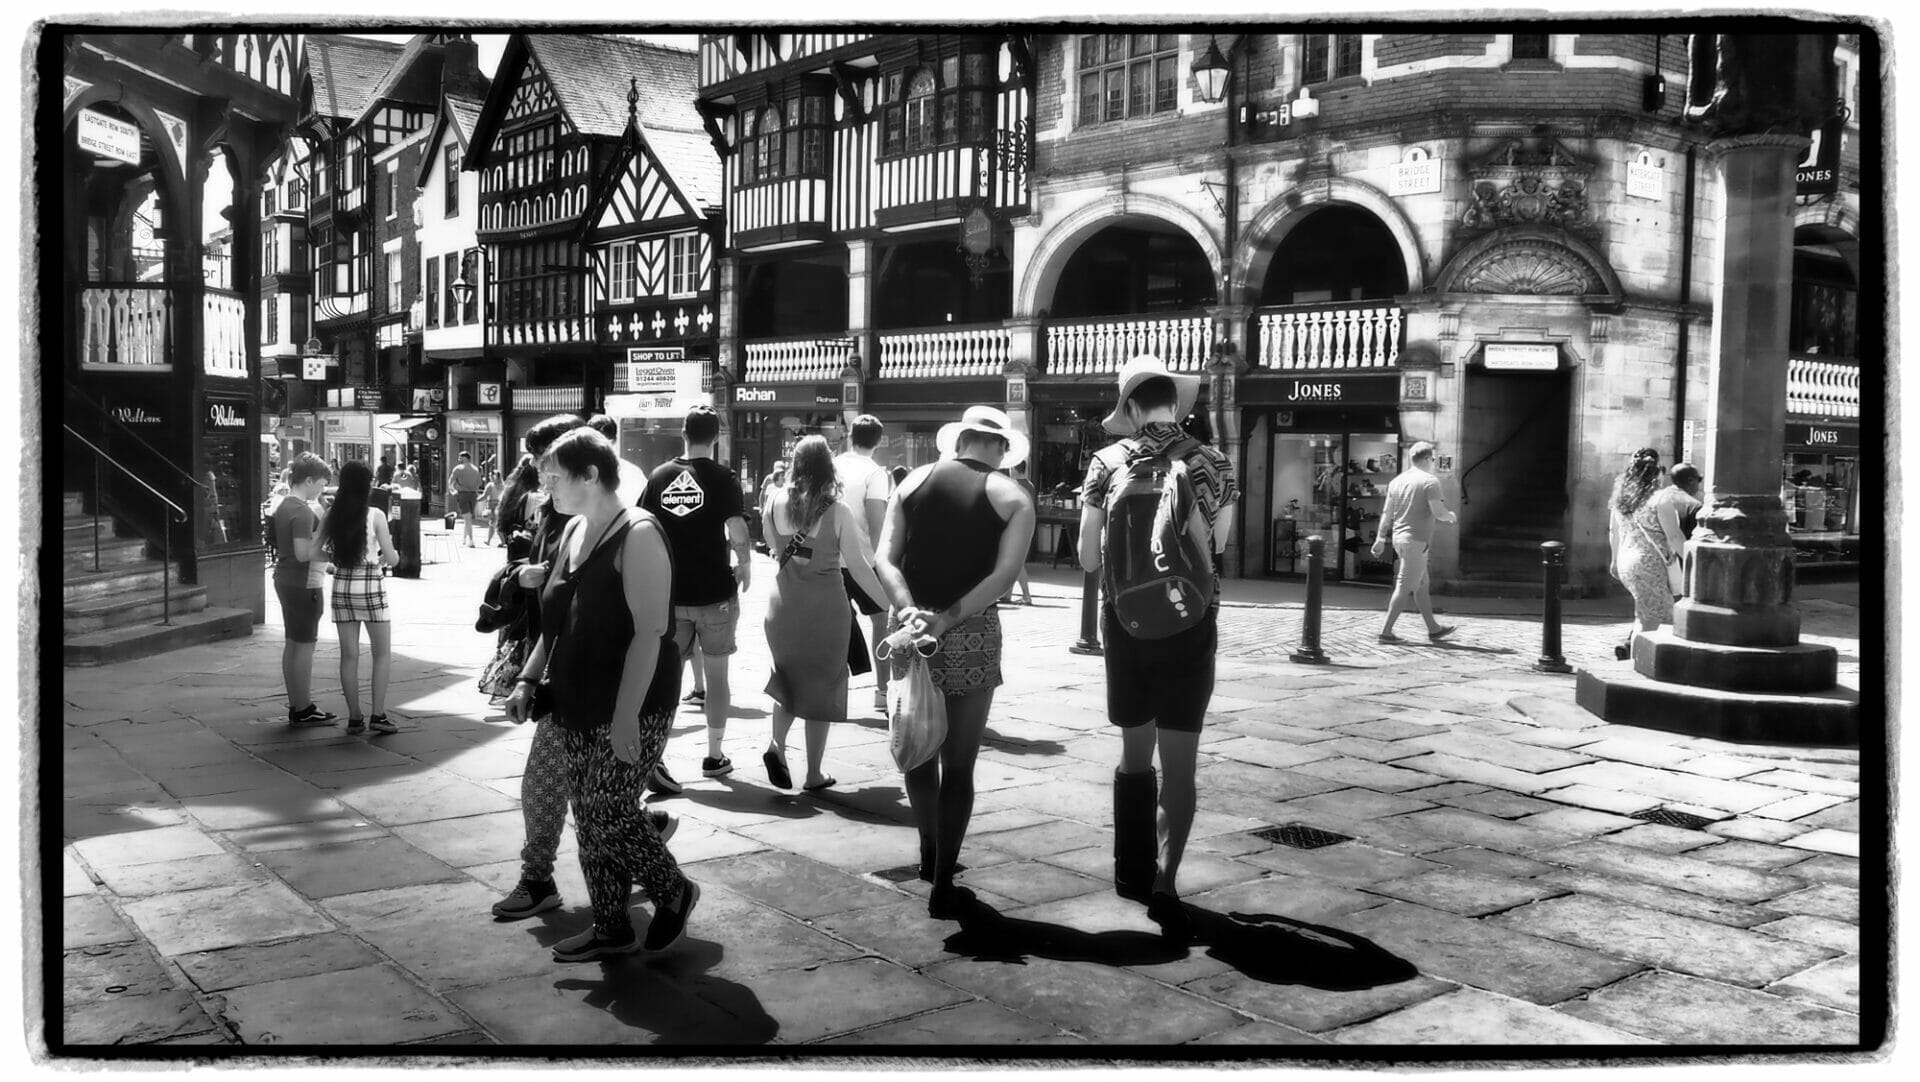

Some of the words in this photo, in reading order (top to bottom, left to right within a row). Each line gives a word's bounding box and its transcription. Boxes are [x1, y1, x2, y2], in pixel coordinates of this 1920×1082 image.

[1399, 165, 1430, 177] BRIDGE
[1795, 169, 1832, 183] ONES
[1399, 177, 1430, 189] STREET
[632, 352, 653, 361] SHOP
[654, 352, 664, 360] TO
[666, 352, 681, 360] LET
[736, 387, 776, 401] Rohan
[1287, 380, 1342, 401] JONES
[111, 407, 161, 423] Waltons
[210, 404, 245, 426] Waltons
[1805, 426, 1838, 446] JONES
[663, 493, 700, 505] element
